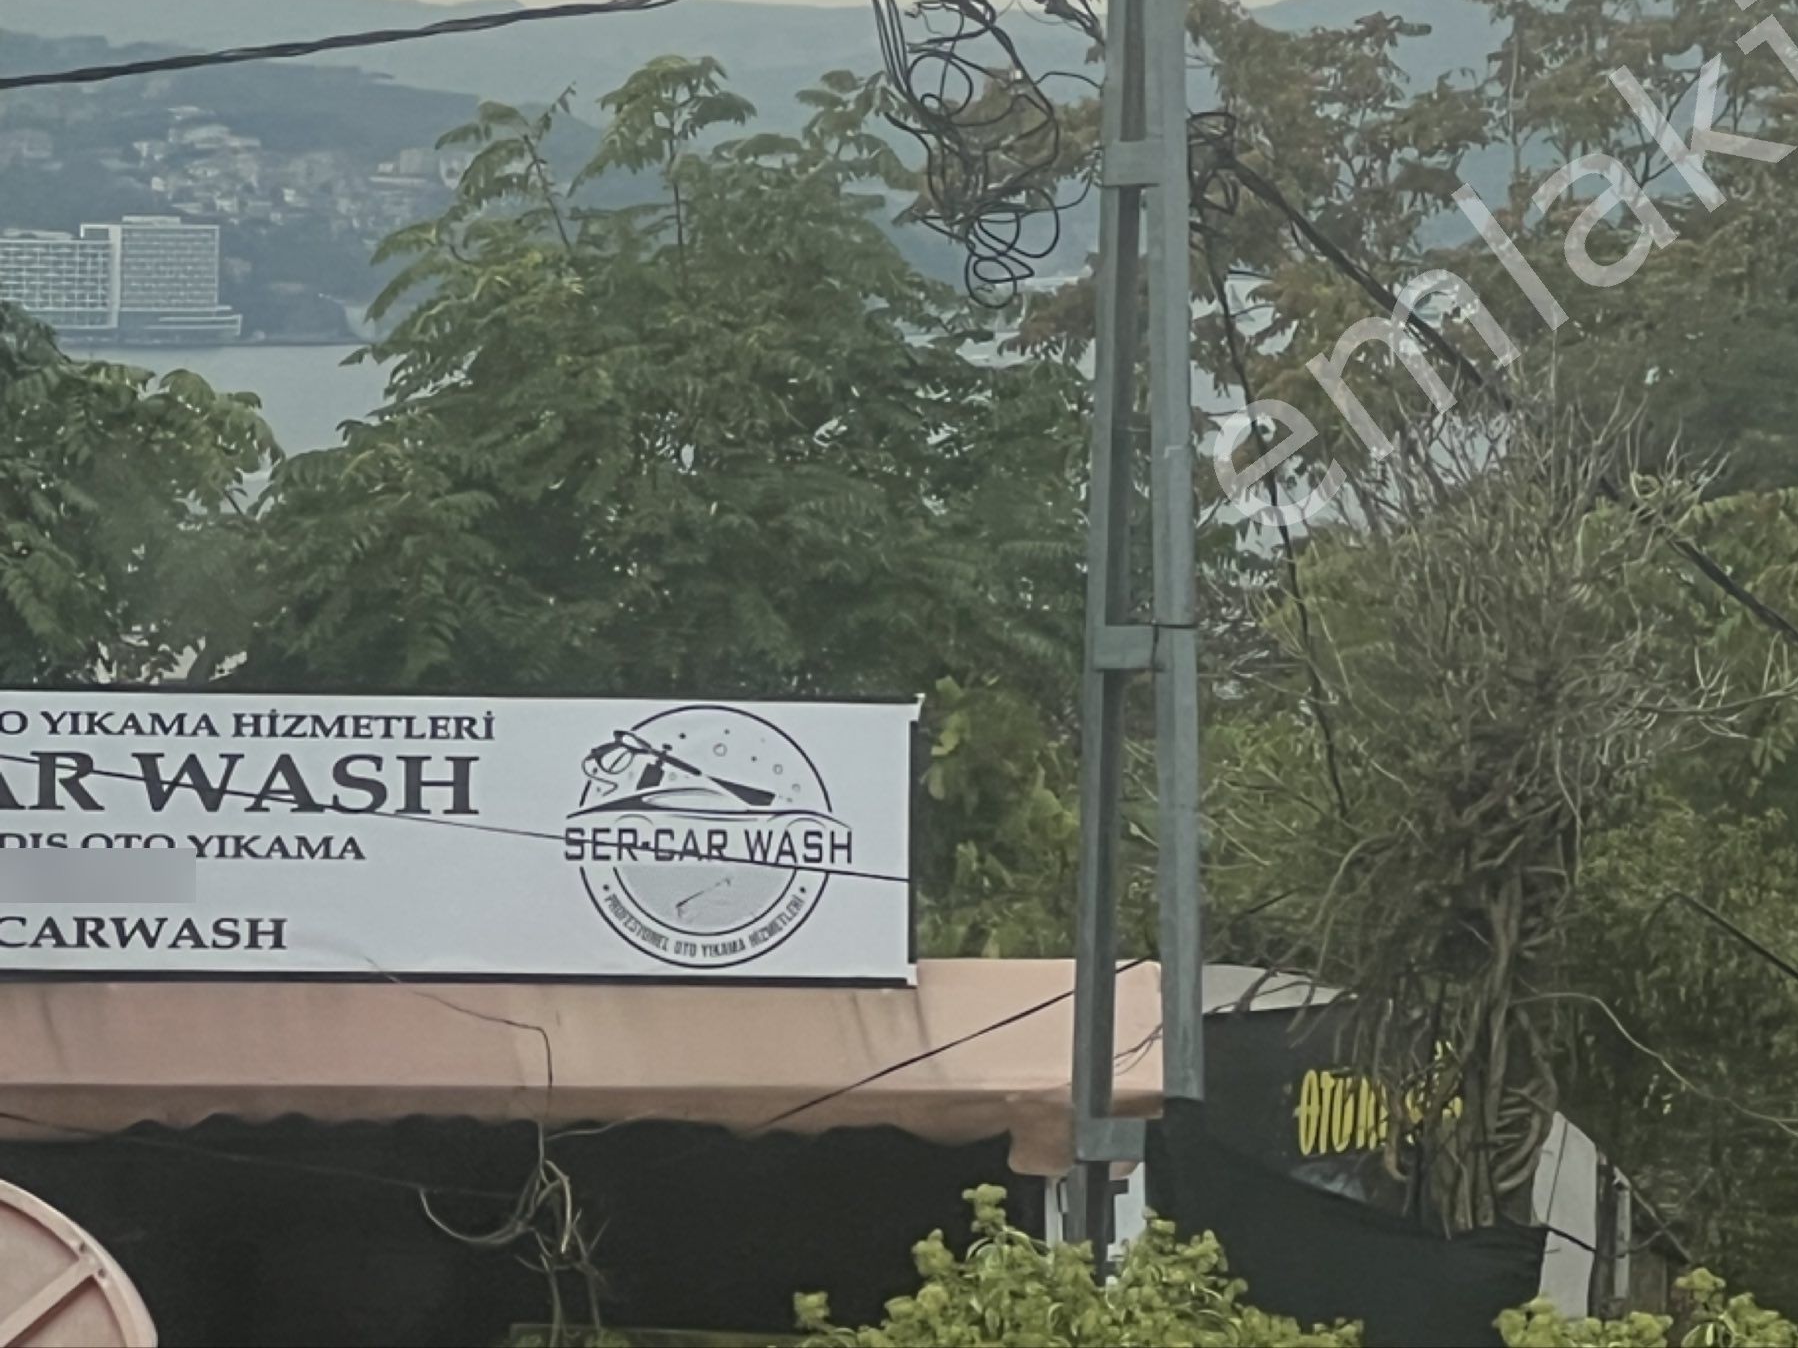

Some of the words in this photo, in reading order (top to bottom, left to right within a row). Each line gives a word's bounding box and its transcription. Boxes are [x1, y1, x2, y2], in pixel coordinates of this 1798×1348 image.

[39, 710, 220, 737] YIKAMA
[231, 708, 496, 741] HİZMETLERİ
[131, 751, 480, 815] WASH
[187, 834, 366, 860] YIKAMA
[744, 830, 853, 864] WASH
